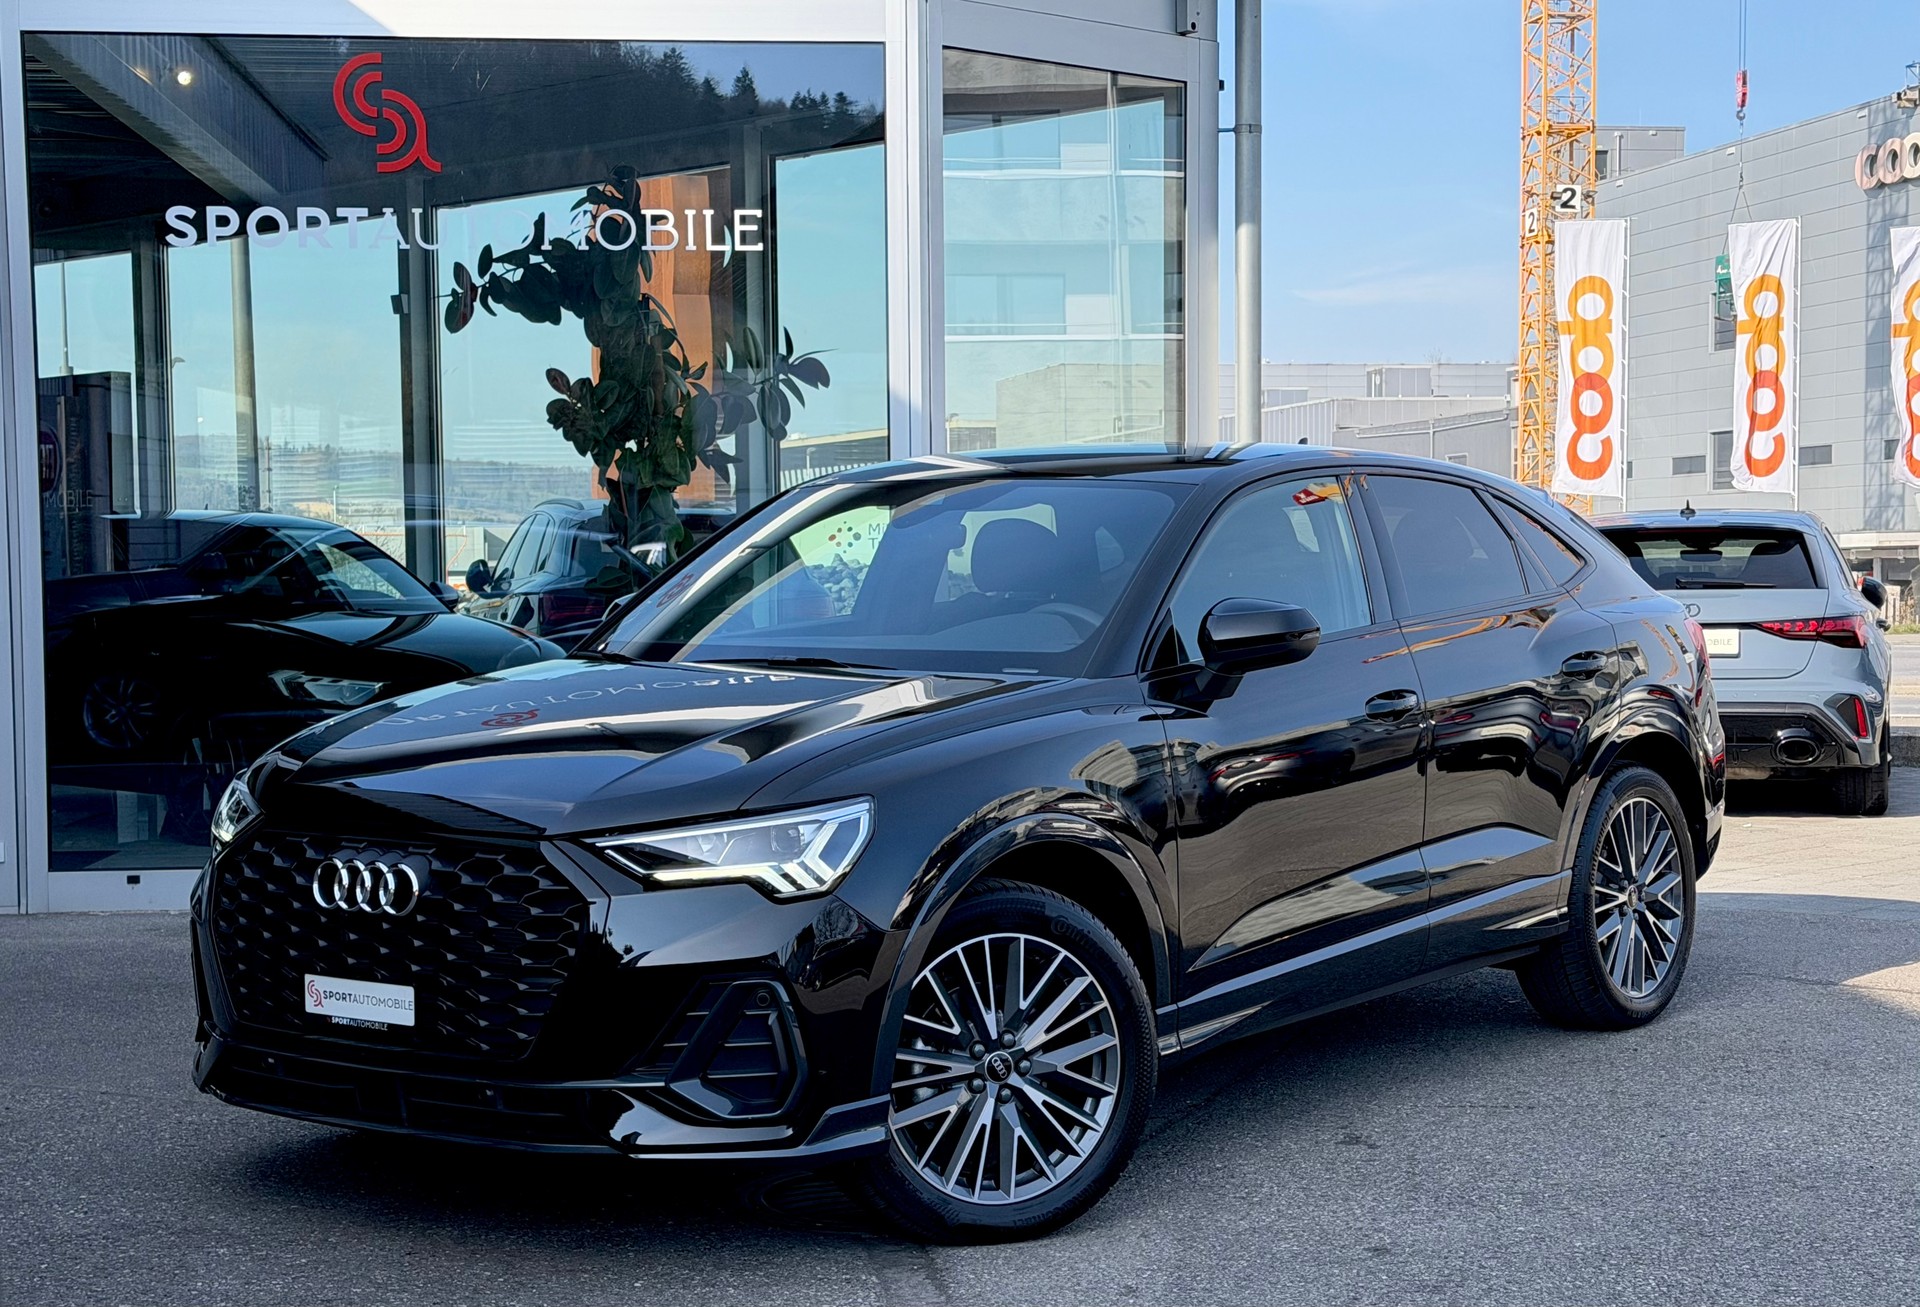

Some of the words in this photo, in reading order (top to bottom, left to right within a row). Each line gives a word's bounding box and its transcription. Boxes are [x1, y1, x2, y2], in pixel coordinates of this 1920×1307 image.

[1560, 187, 1577, 209] 2
[164, 205, 764, 252] SPORTAUOMOBILE
[1528, 212, 1535, 234] 2
[1558, 274, 1614, 480] coop
[1736, 274, 1786, 477] coop
[322, 990, 413, 1011] SPORTAUTOMOBILE
[331, 1016, 388, 1031] SPORTAUTOMOBILE
